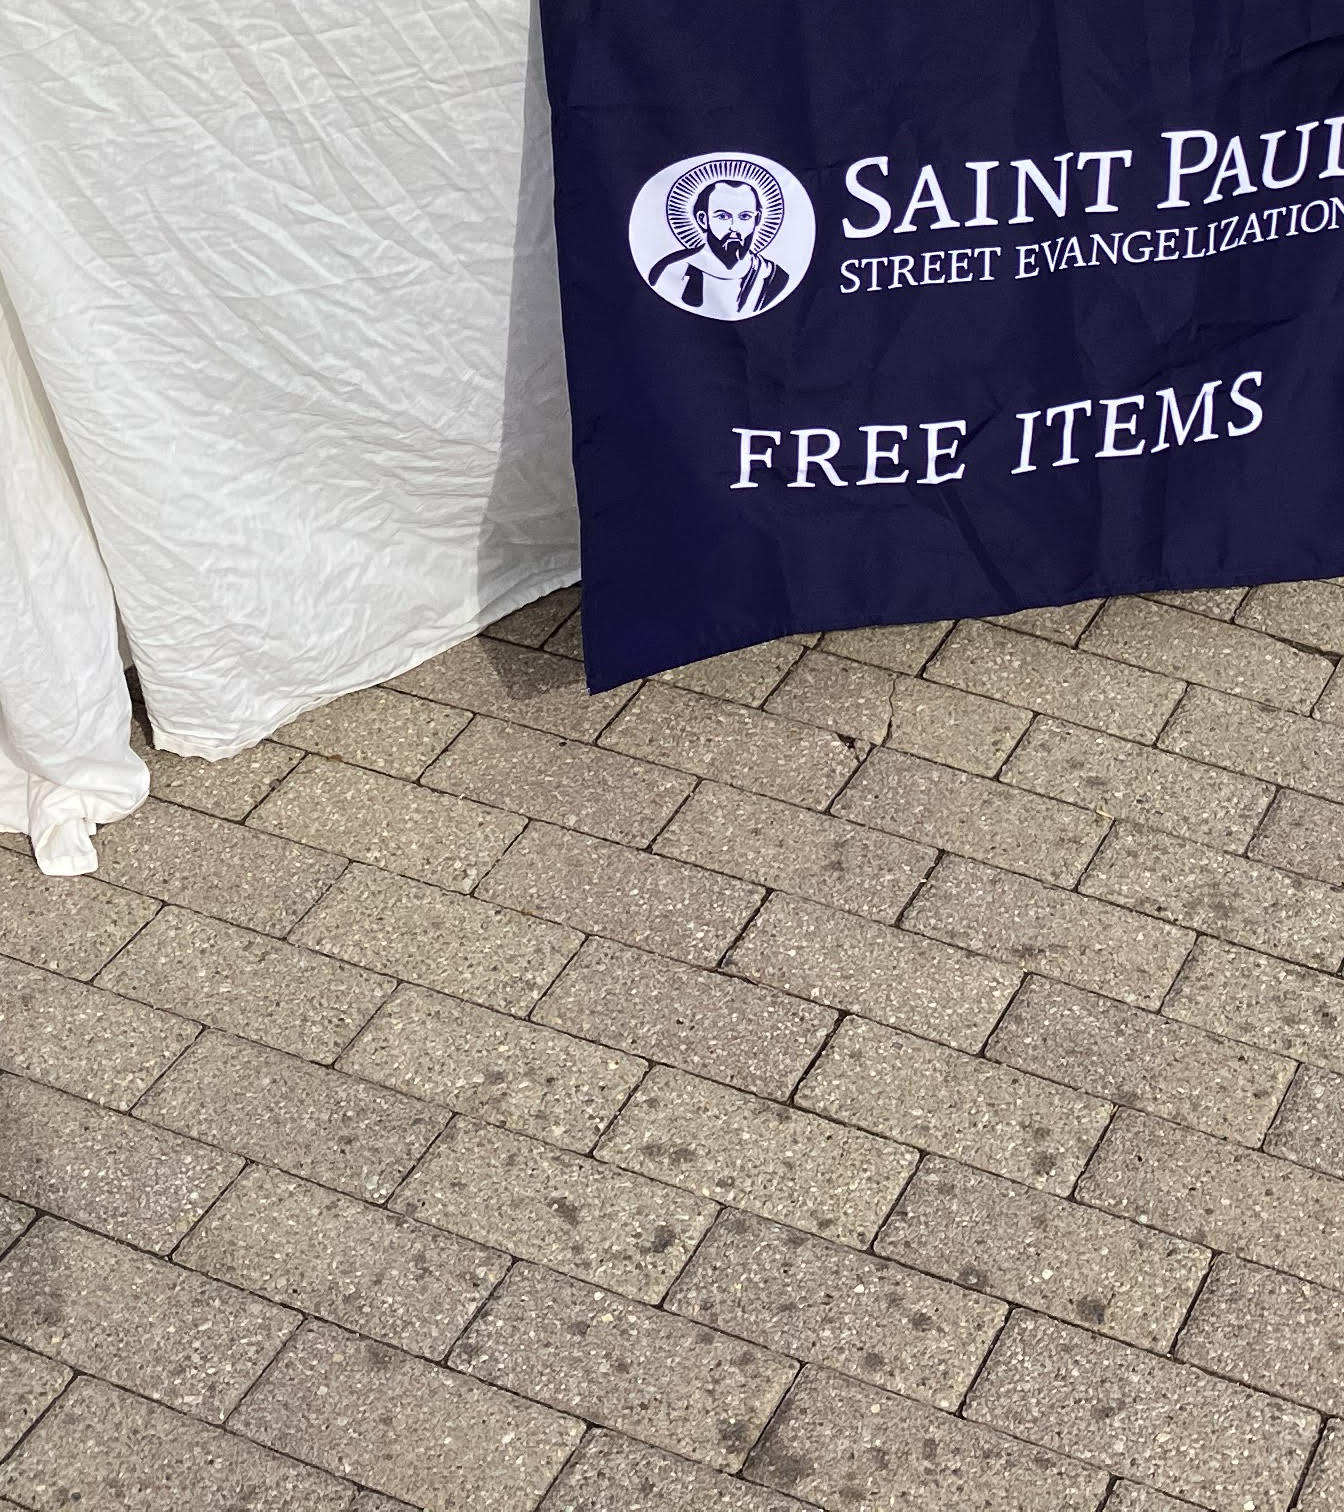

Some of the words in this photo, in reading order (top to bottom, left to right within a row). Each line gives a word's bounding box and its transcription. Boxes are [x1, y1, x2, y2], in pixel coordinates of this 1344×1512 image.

[841, 147, 1133, 240] SAINT
[839, 245, 1002, 295] STREET
[729, 417, 969, 491] FREE
[1009, 369, 1265, 477] ITEMS
